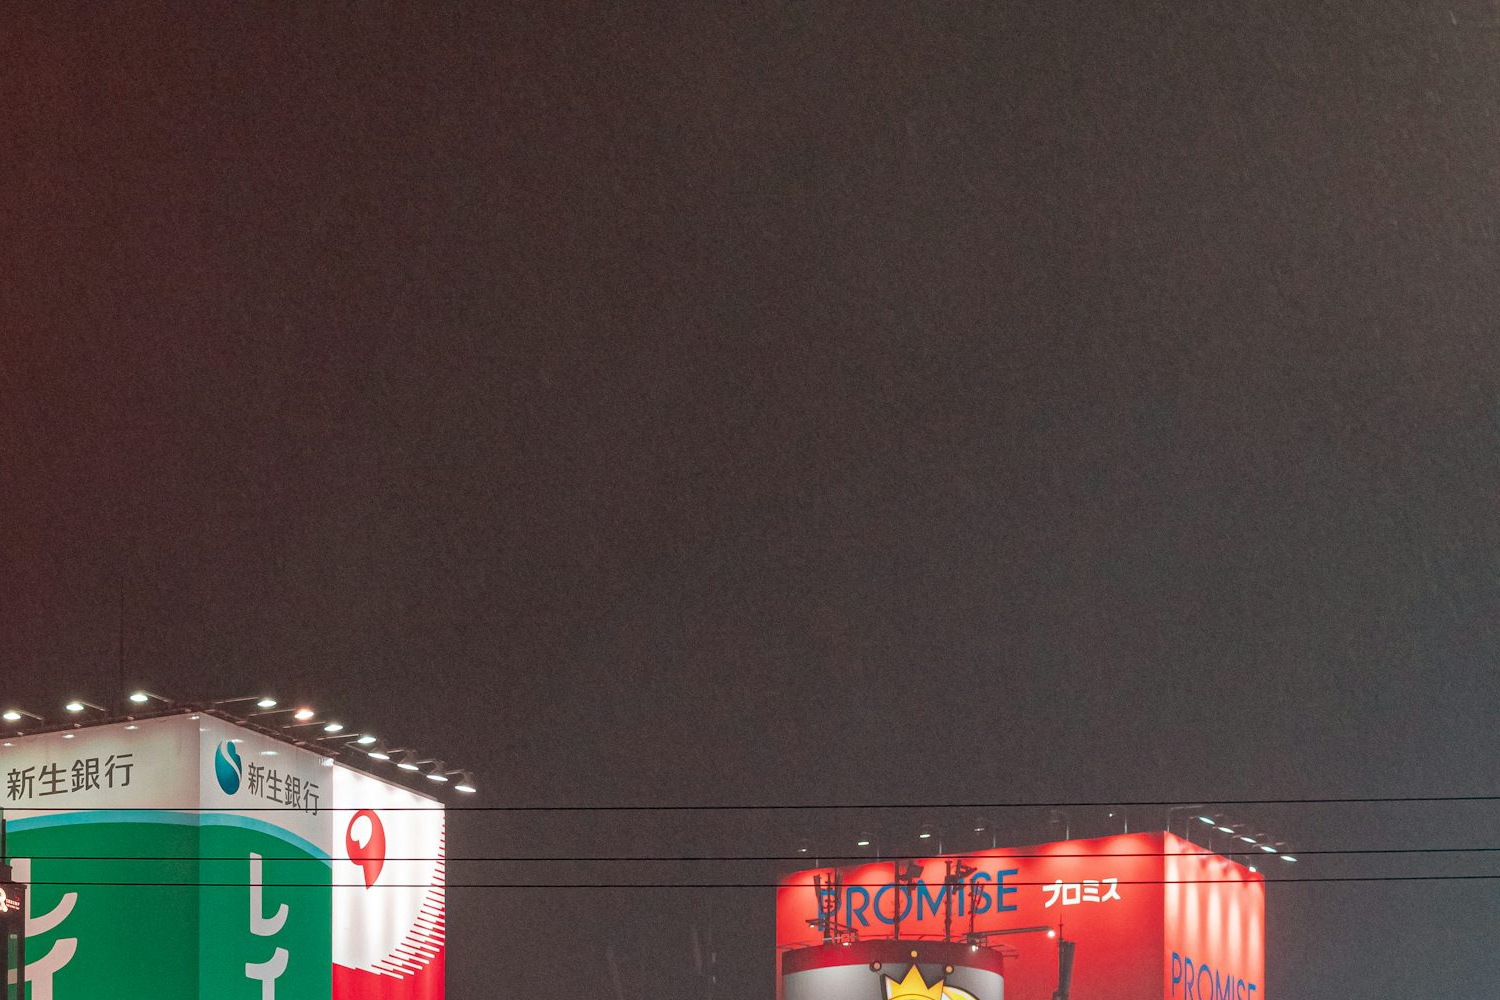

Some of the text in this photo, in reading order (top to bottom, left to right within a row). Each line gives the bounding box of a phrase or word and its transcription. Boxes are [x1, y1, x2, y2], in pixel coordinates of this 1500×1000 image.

[7, 753, 134, 801] 新生銀行
[247, 762, 320, 816] 新生銀行
[817, 868, 1019, 932] PROMISE
[1042, 878, 1121, 908] プロミス
